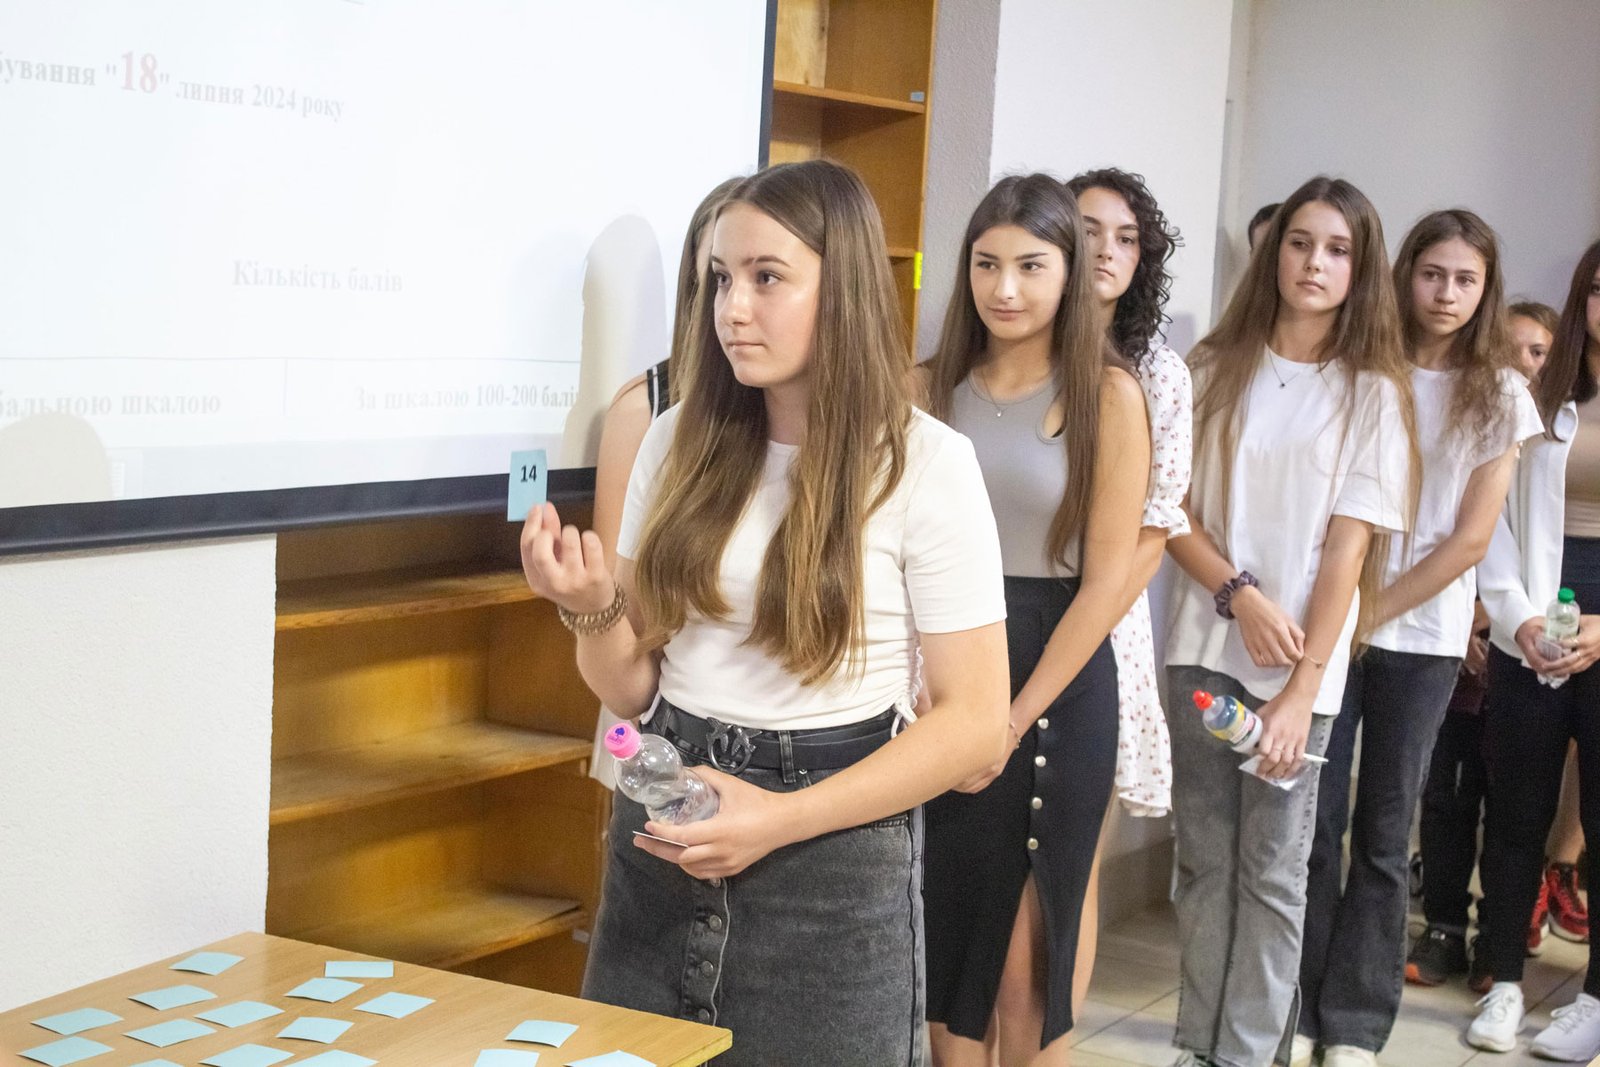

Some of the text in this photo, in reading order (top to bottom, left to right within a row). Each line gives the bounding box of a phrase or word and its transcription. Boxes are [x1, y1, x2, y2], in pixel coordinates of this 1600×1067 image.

[175, 80, 244, 106] липня
[251, 84, 297, 111] 2024
[301, 94, 345, 124] року
[232, 257, 404, 293] Кількість балів
[120, 394, 222, 416] шкалою
[353, 384, 377, 411] За
[384, 387, 470, 409] шкалою
[476, 384, 538, 408] 100-200
[520, 464, 537, 483] 14
